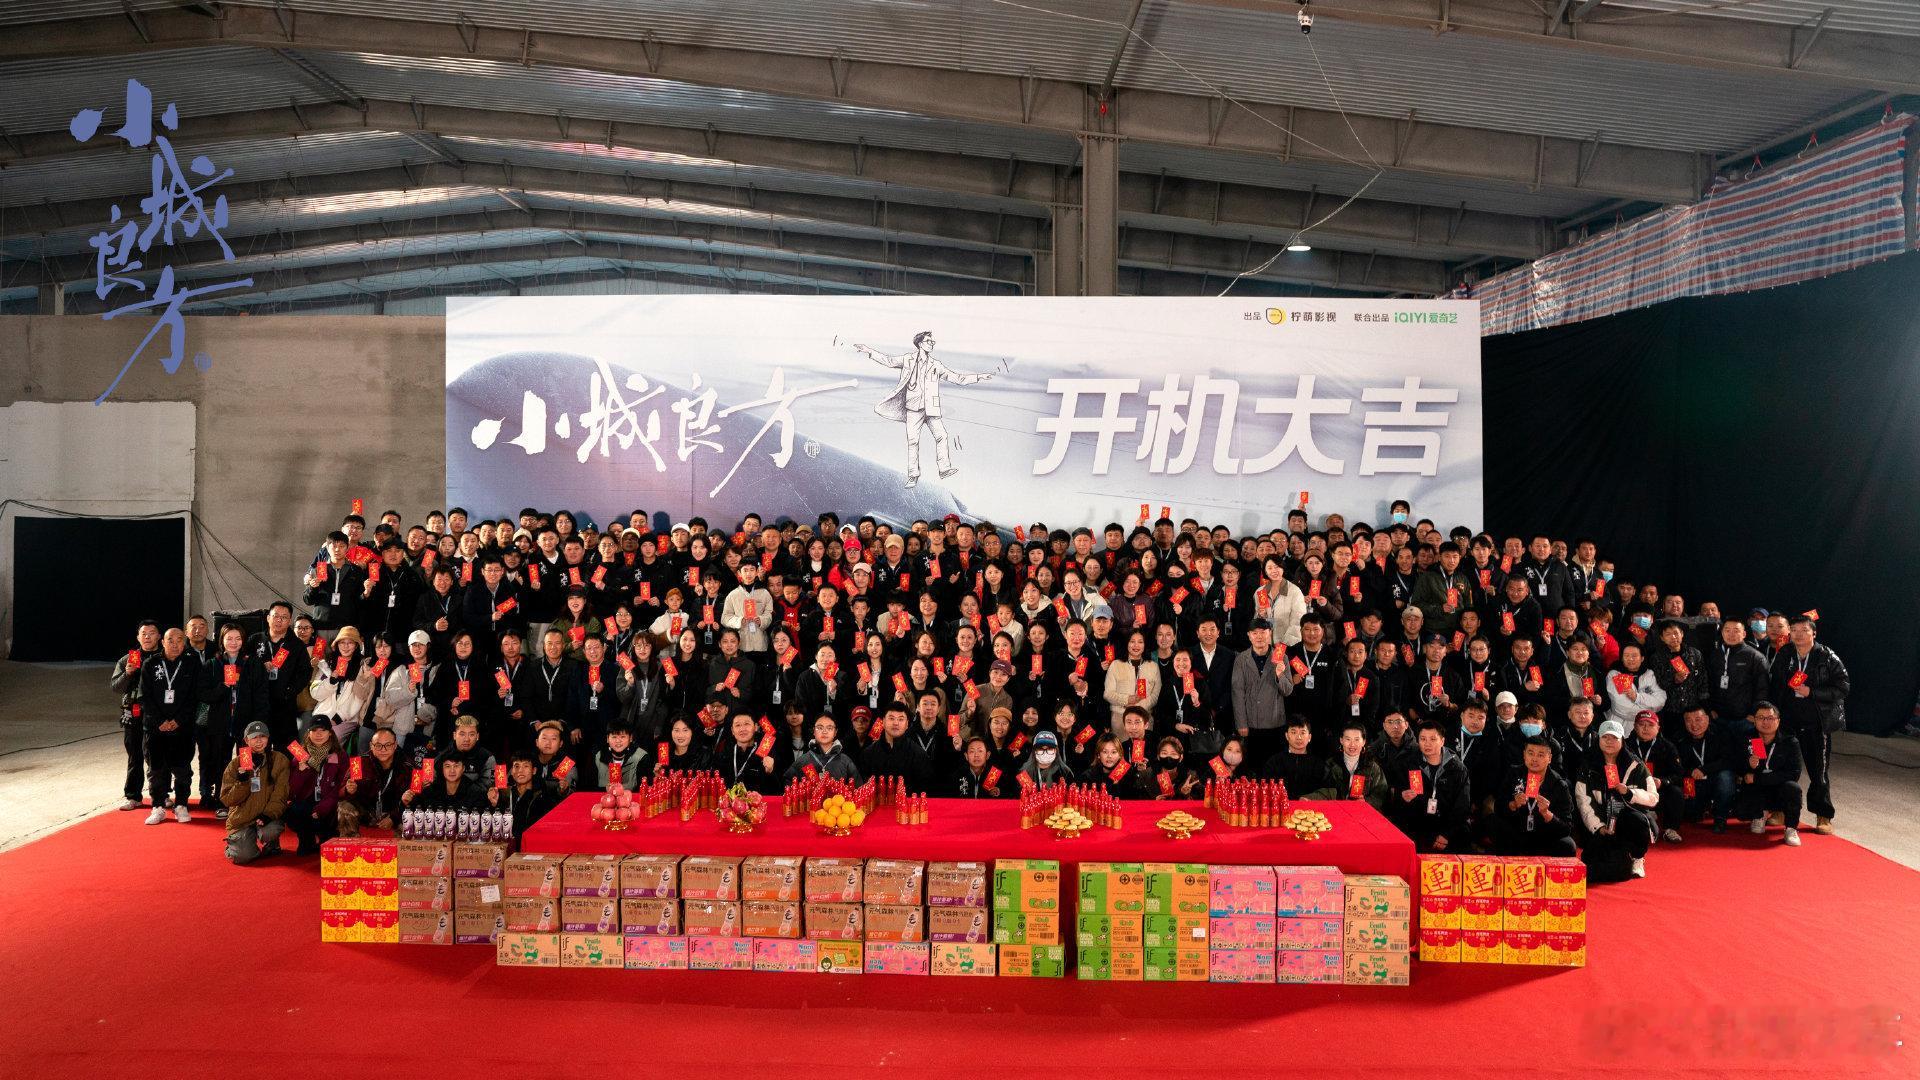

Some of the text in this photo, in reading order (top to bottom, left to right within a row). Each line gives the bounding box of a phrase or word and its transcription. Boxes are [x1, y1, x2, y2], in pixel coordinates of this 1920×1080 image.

[1244, 311, 1337, 323] 出品 柠萌影视
[1354, 313, 1390, 323] 联合出品
[471, 357, 858, 498] 小城良方
[1032, 373, 1459, 476] 开机大吉
[996, 871, 1007, 890] if
[1081, 874, 1093, 893] if
[1146, 874, 1158, 894] if
